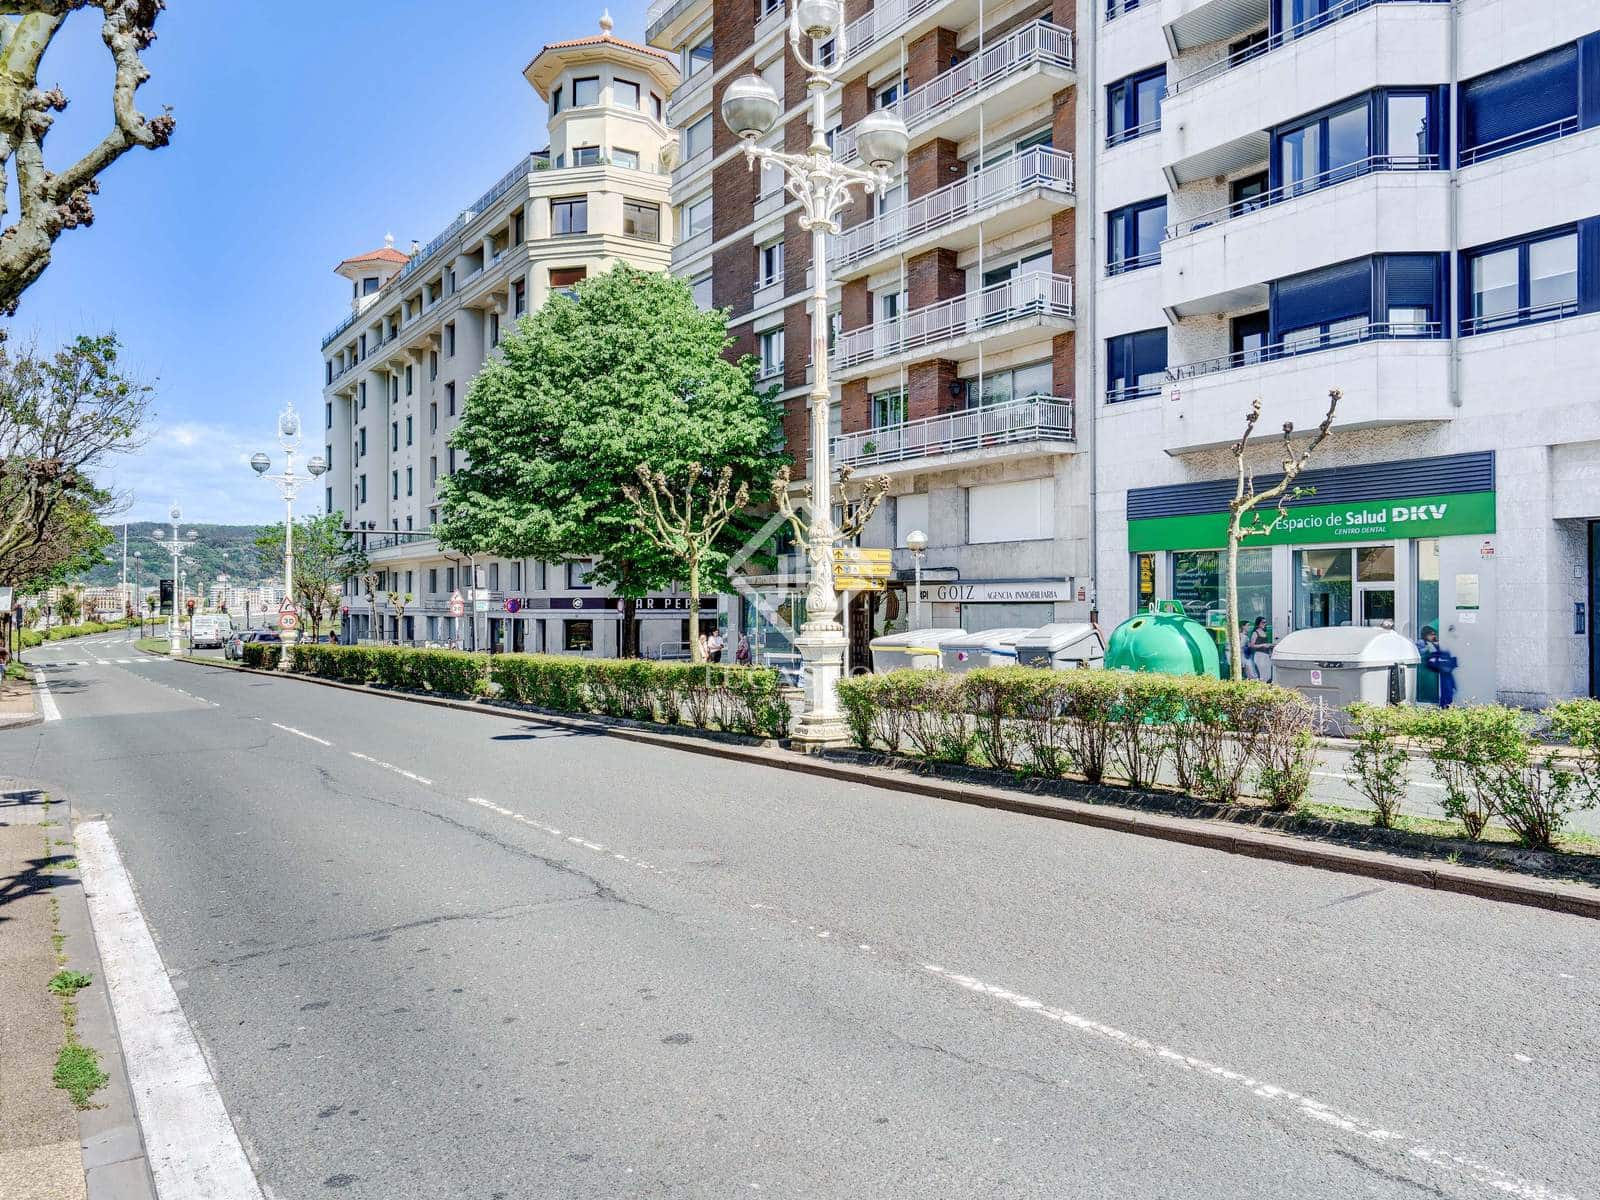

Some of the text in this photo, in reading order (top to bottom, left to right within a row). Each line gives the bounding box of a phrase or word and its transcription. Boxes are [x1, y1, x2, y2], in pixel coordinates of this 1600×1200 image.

[1276, 503, 1448, 532] Espacio de Salud DKV
[1334, 526, 1386, 535] CENTRO DENTAL
[937, 585, 975, 600] GOIZ
[987, 591, 1013, 600] AGENCIA
